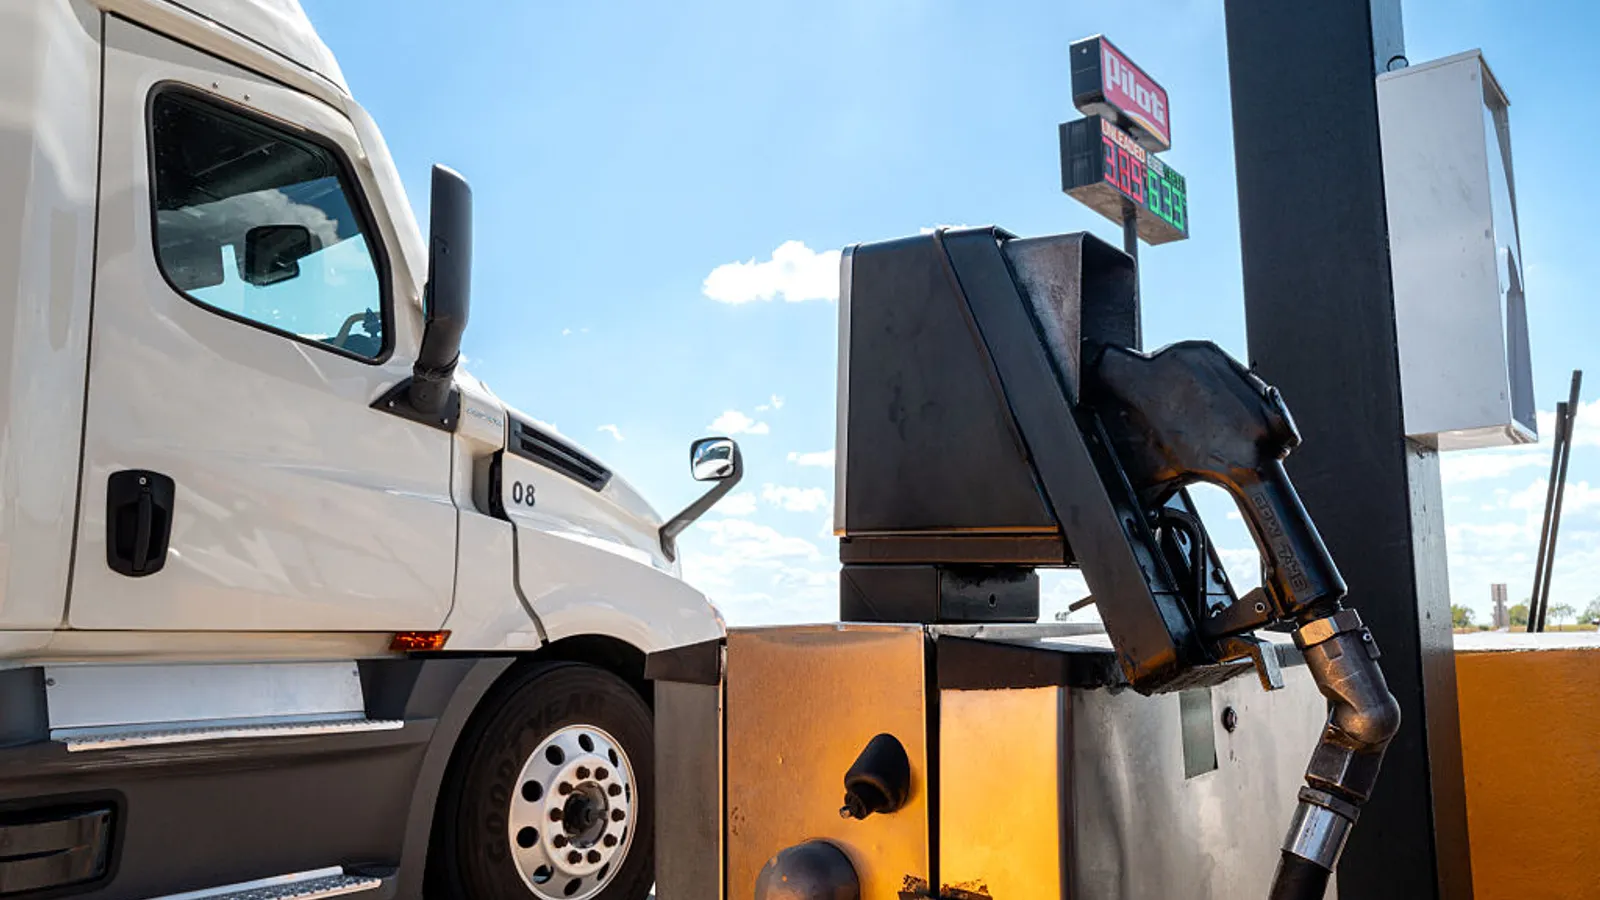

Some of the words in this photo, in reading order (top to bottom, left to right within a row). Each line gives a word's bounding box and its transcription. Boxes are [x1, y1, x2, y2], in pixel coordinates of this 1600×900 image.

[1103, 48, 1165, 127] Pilot
[1101, 117, 1146, 163] UNLEADED
[512, 480, 536, 507] 08
